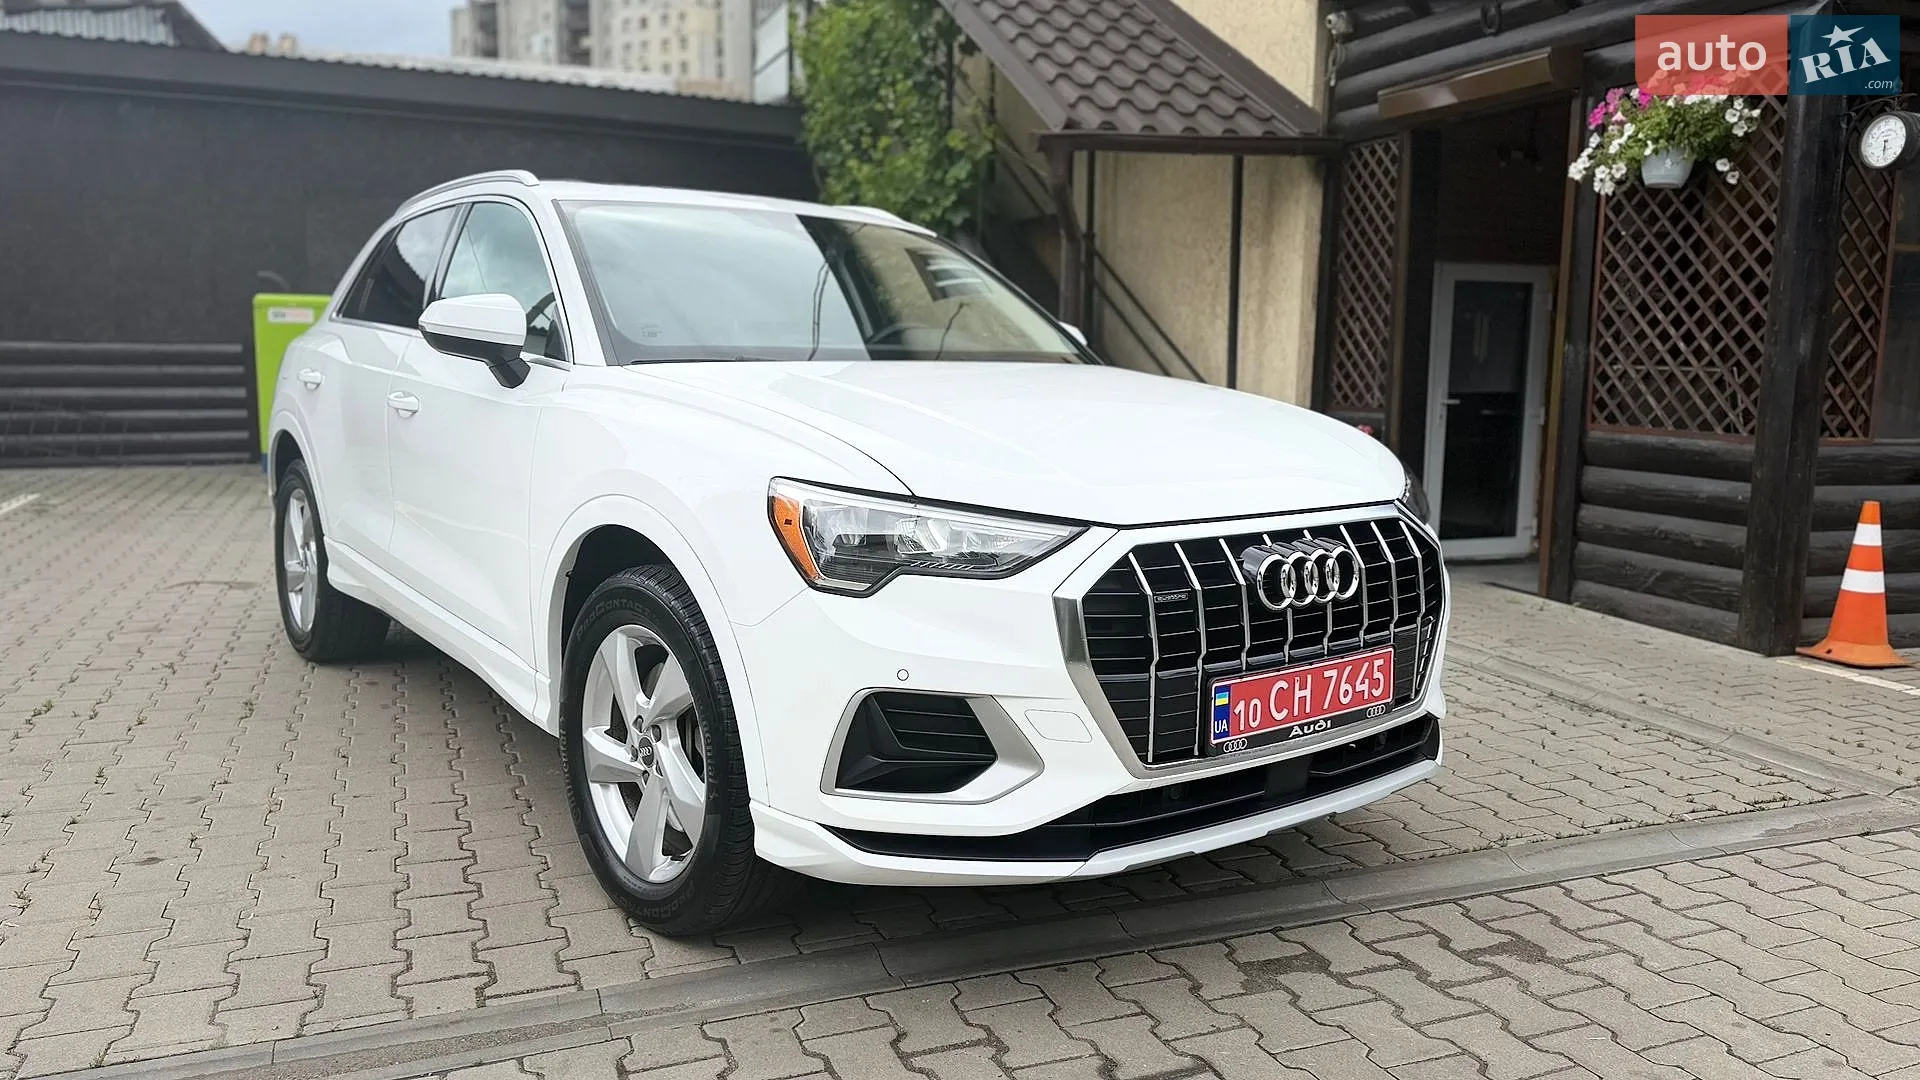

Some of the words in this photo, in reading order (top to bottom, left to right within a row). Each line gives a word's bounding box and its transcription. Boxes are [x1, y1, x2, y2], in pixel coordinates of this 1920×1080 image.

[1234, 698, 1262, 731] 10
[1269, 674, 1312, 721] CH
[1322, 658, 1385, 710] 7645
[1214, 719, 1229, 734] UA
[1288, 719, 1331, 738] Audi
